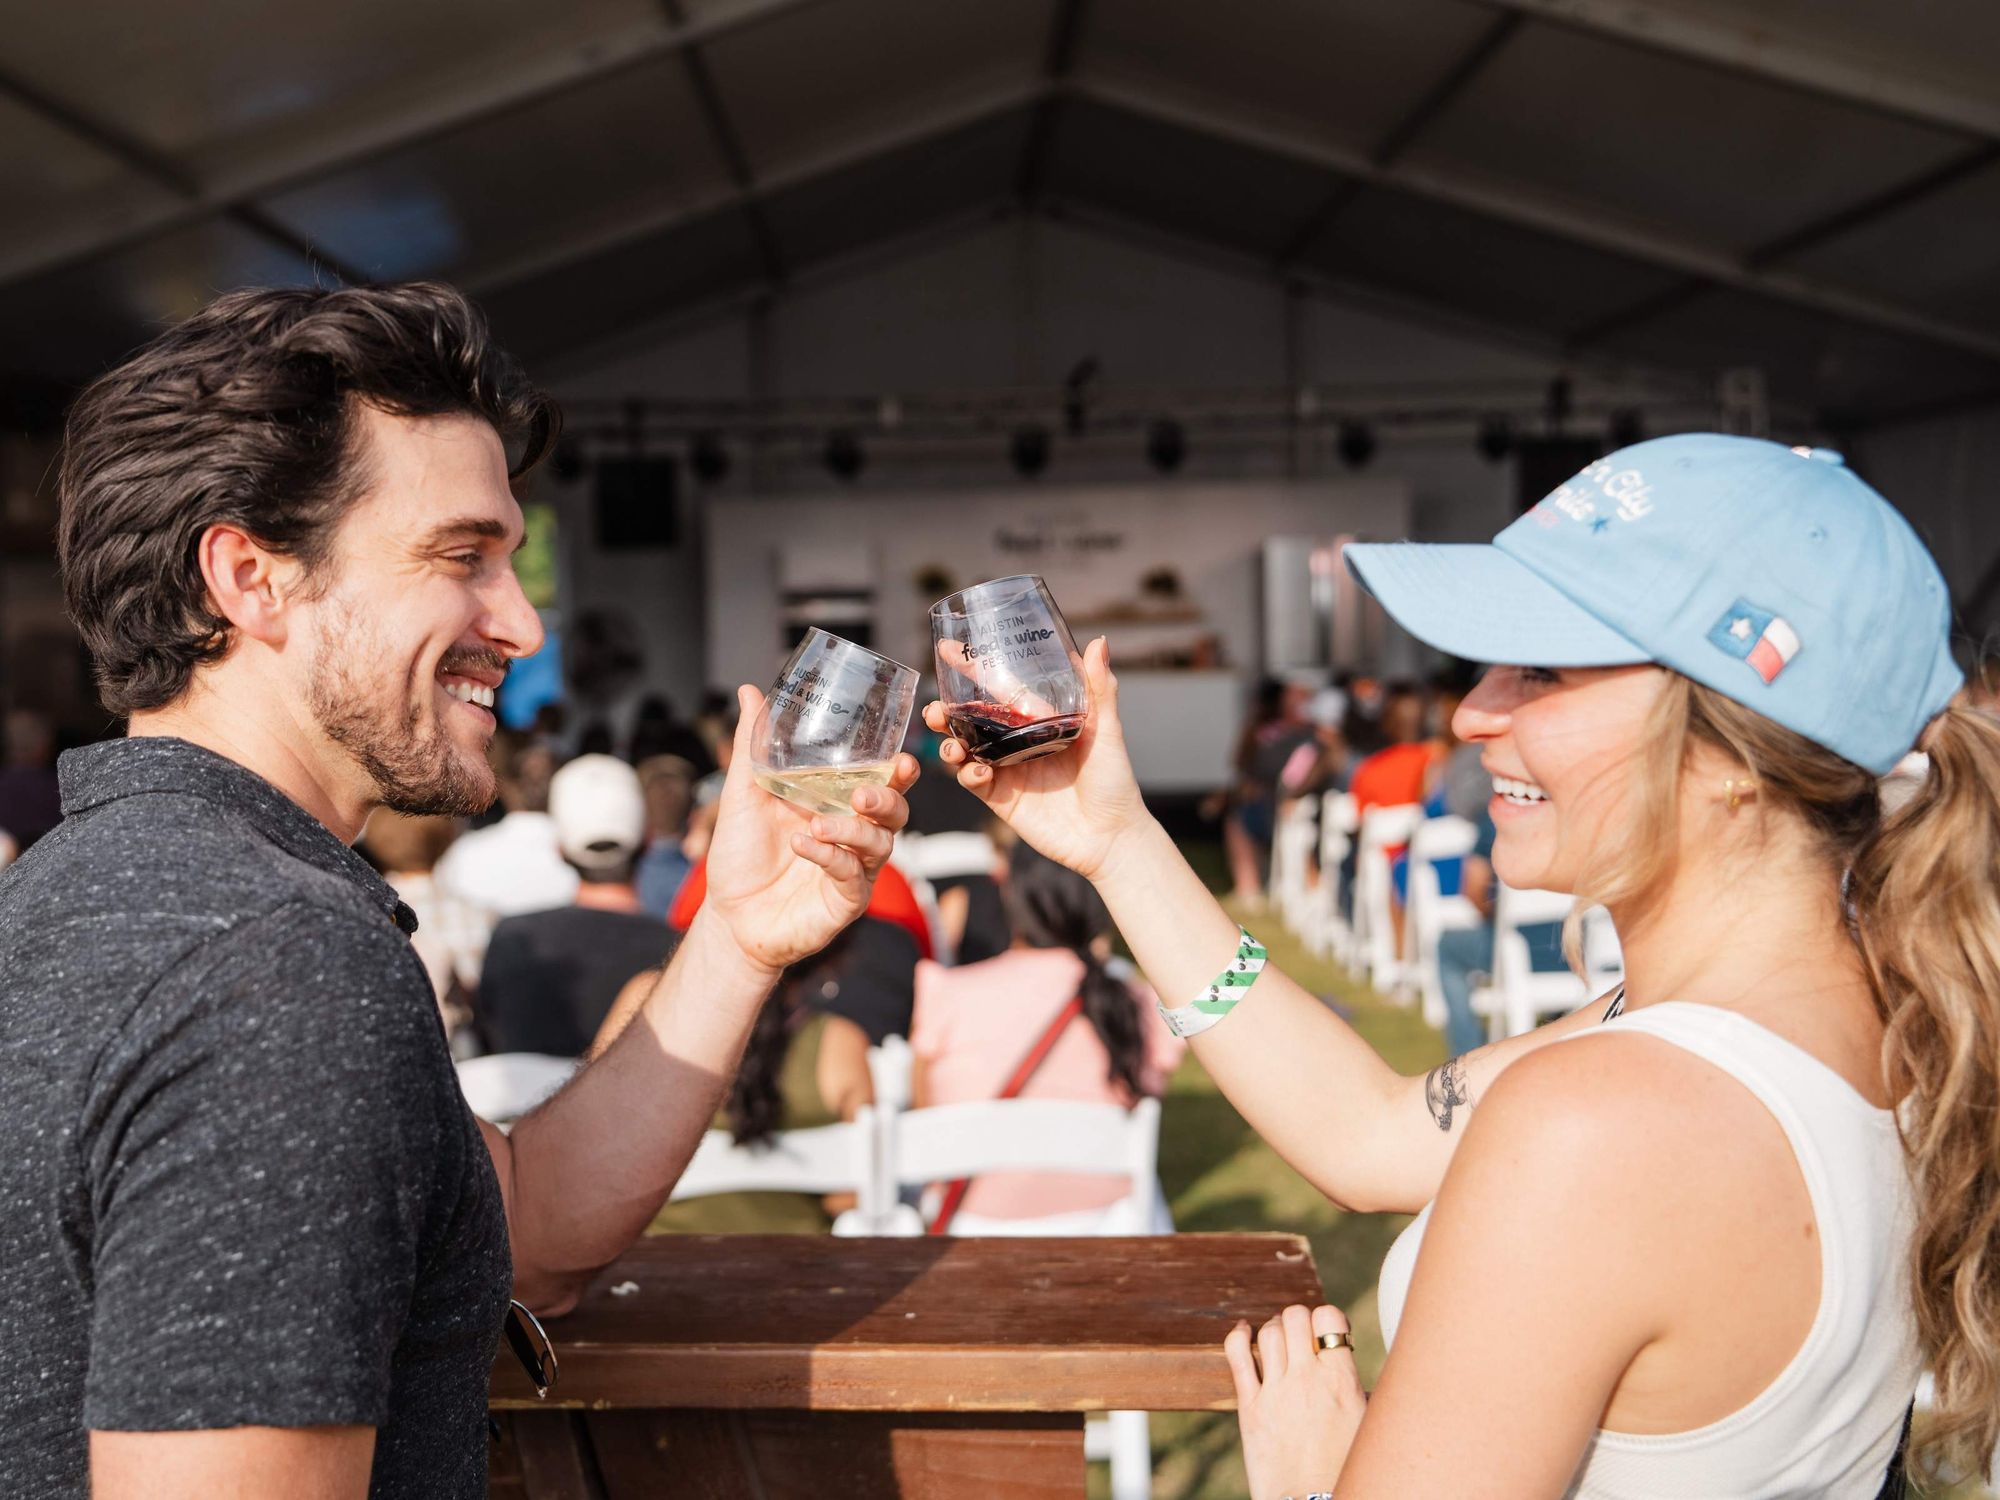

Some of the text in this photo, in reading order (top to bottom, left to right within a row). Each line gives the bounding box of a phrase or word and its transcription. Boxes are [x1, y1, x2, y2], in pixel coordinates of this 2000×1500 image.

[980, 615, 1025, 637] AUSTIN
[961, 628, 1055, 662] food & wine
[981, 646, 1042, 670] FESTIVAL
[792, 667, 829, 688] AUSTIN
[796, 688, 804, 697] &
[805, 691, 850, 715] wine
